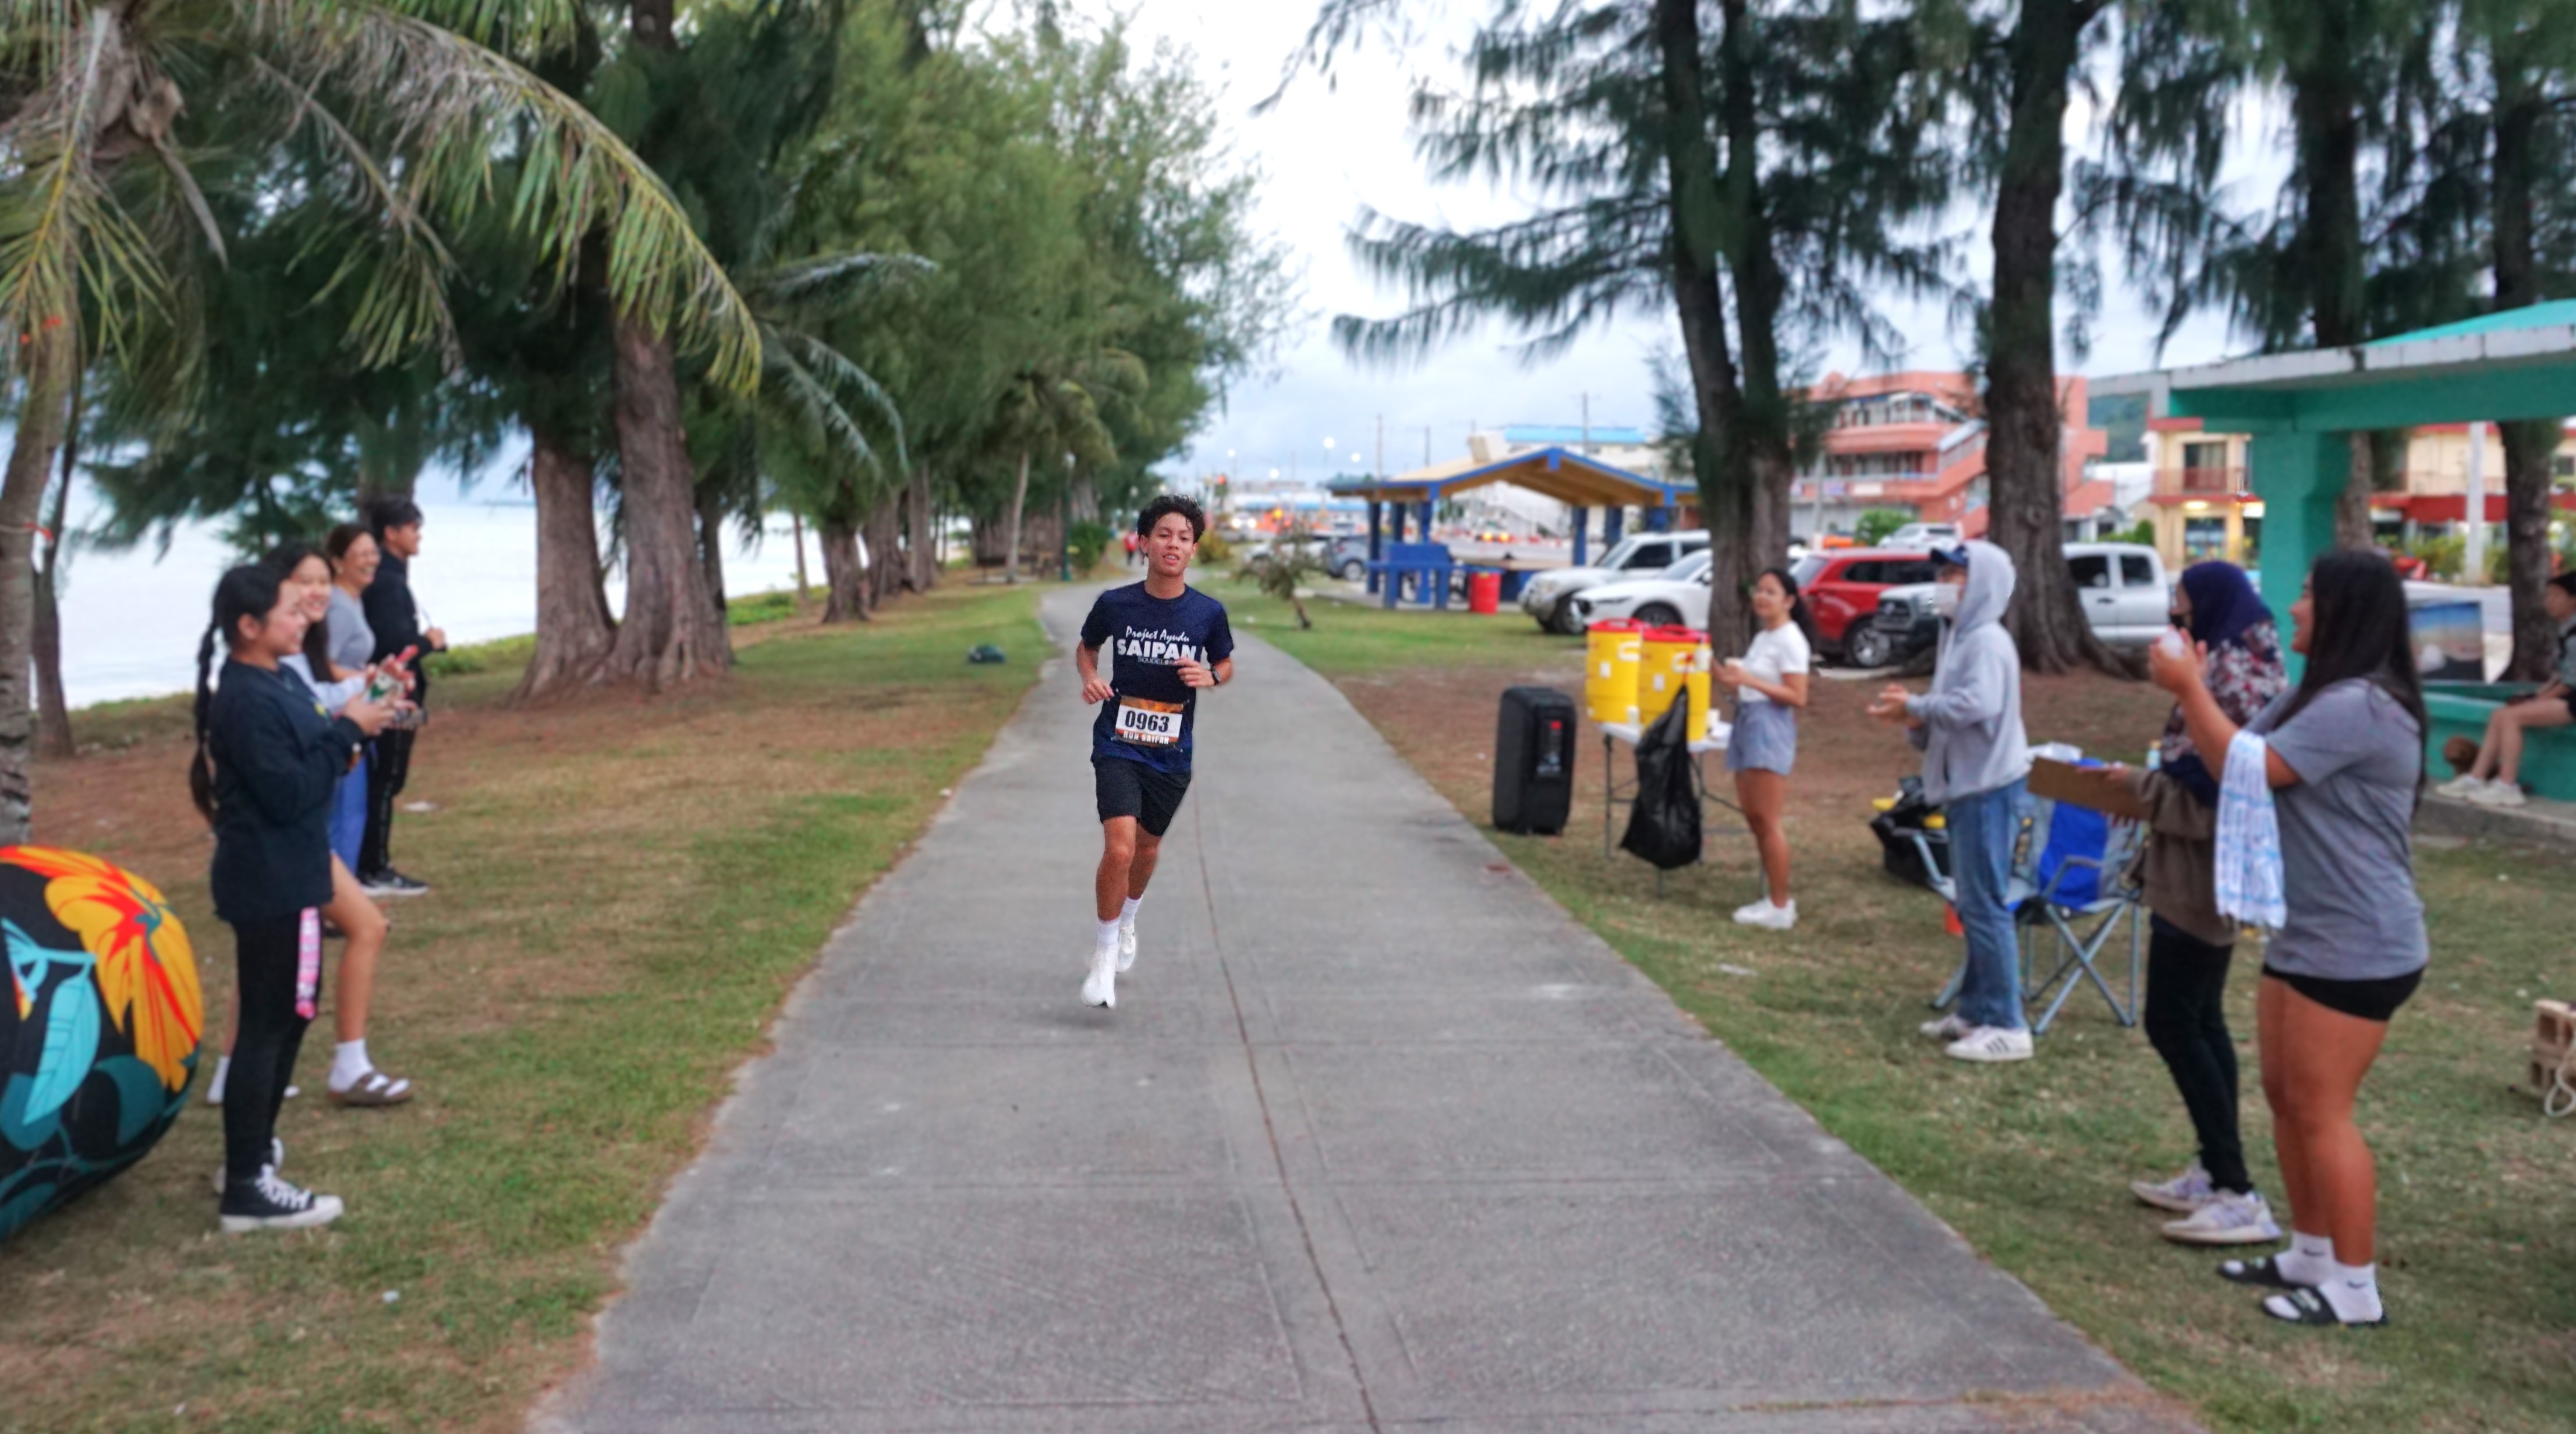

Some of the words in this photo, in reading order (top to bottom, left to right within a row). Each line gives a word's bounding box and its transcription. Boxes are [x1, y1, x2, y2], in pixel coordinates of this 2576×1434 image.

[1126, 625, 1158, 642] Project
[1117, 639, 1197, 660] SAIPAN
[1125, 710, 1170, 732] 0963
[1124, 731, 1139, 740] RUN
[1141, 734, 1169, 745] SAIPAN
